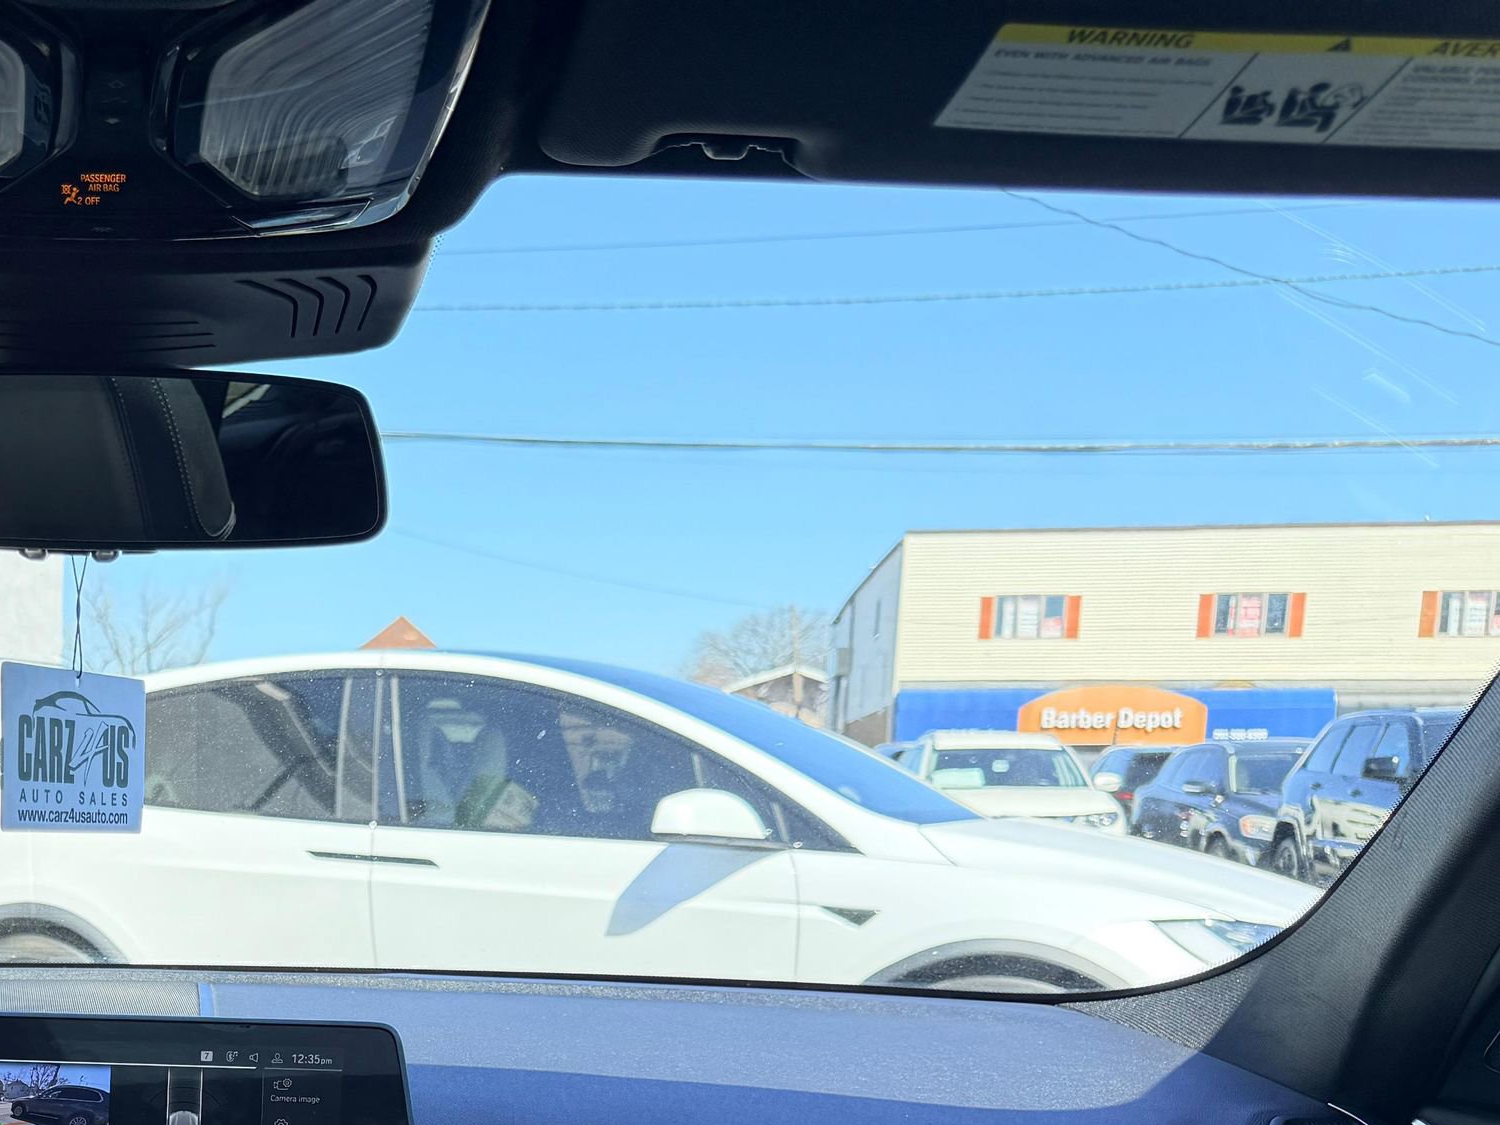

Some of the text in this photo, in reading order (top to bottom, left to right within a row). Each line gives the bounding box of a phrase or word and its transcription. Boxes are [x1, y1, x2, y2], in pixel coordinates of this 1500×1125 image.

[1066, 29, 1197, 49] WARNING
[80, 173, 126, 183] PASSENGER
[88, 184, 120, 192] AIR BAG
[84, 196, 100, 205] OFF
[1040, 706, 1183, 734] Barber Depot
[19, 788, 128, 807] AUTO SALES
[18, 807, 128, 825] www.carz4usauto.com
[270, 1094, 321, 1105] Camera image
